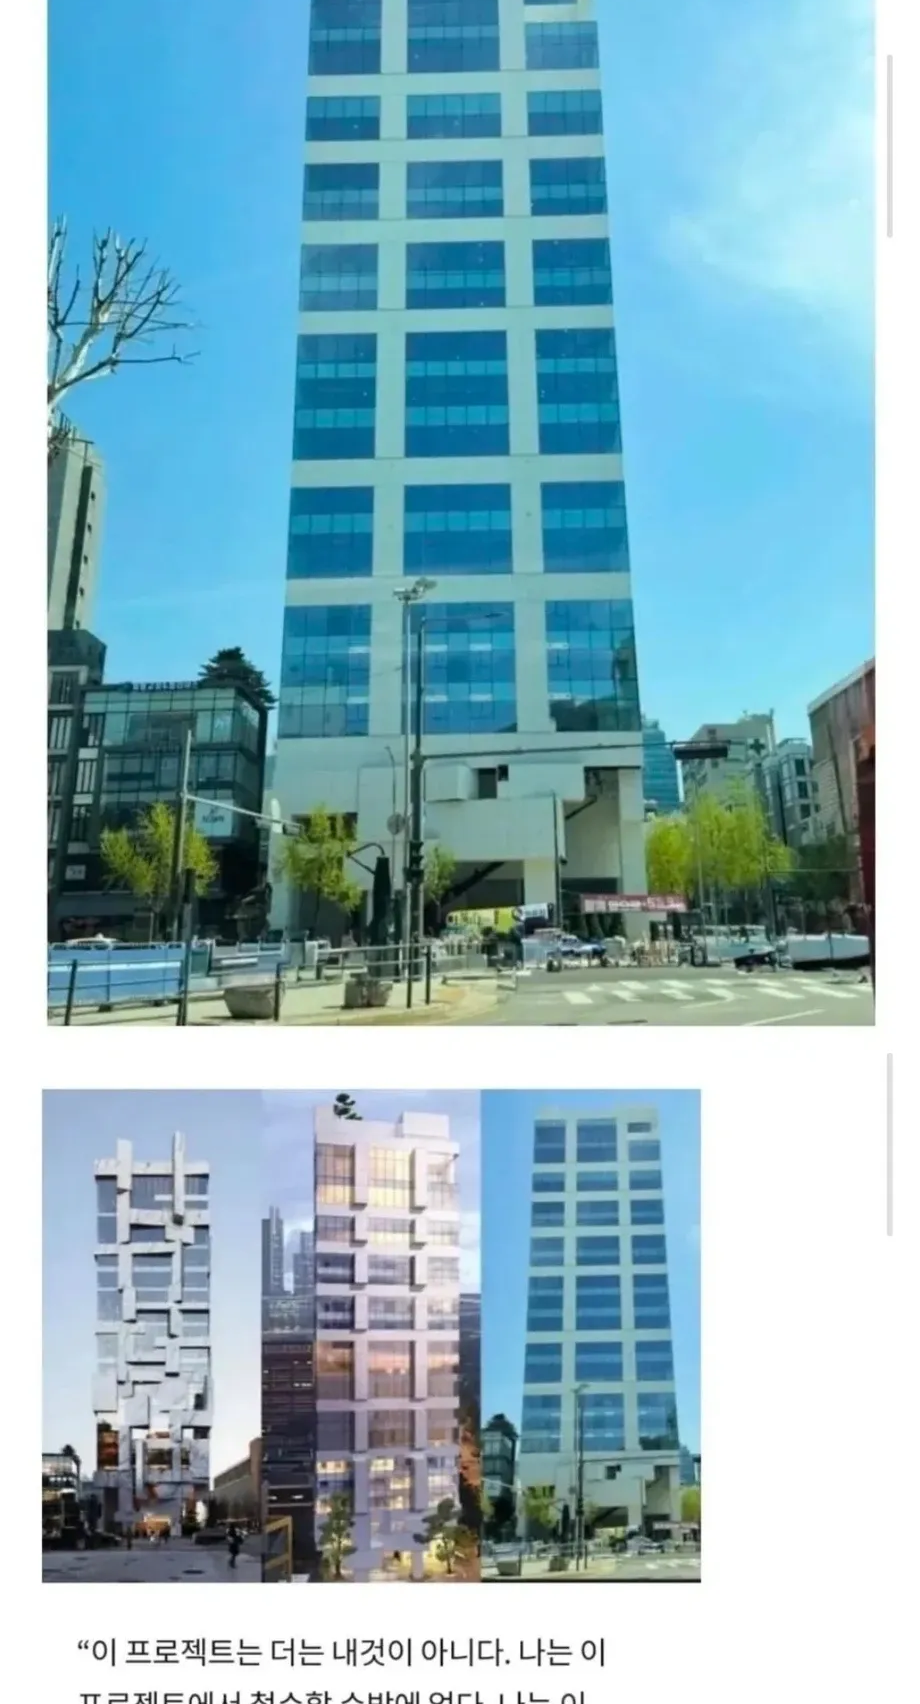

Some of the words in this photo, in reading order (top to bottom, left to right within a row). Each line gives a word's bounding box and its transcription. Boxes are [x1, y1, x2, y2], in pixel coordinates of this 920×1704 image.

[77, 1637, 116, 1668] “이
[125, 1637, 263, 1668] 프로젝트는
[271, 1637, 325, 1668] 더는
[332, 1637, 412, 1668] 내것이
[421, 1637, 511, 1668] 아니다.
[519, 1637, 573, 1668] 나는
[580, 1637, 605, 1668] 이
